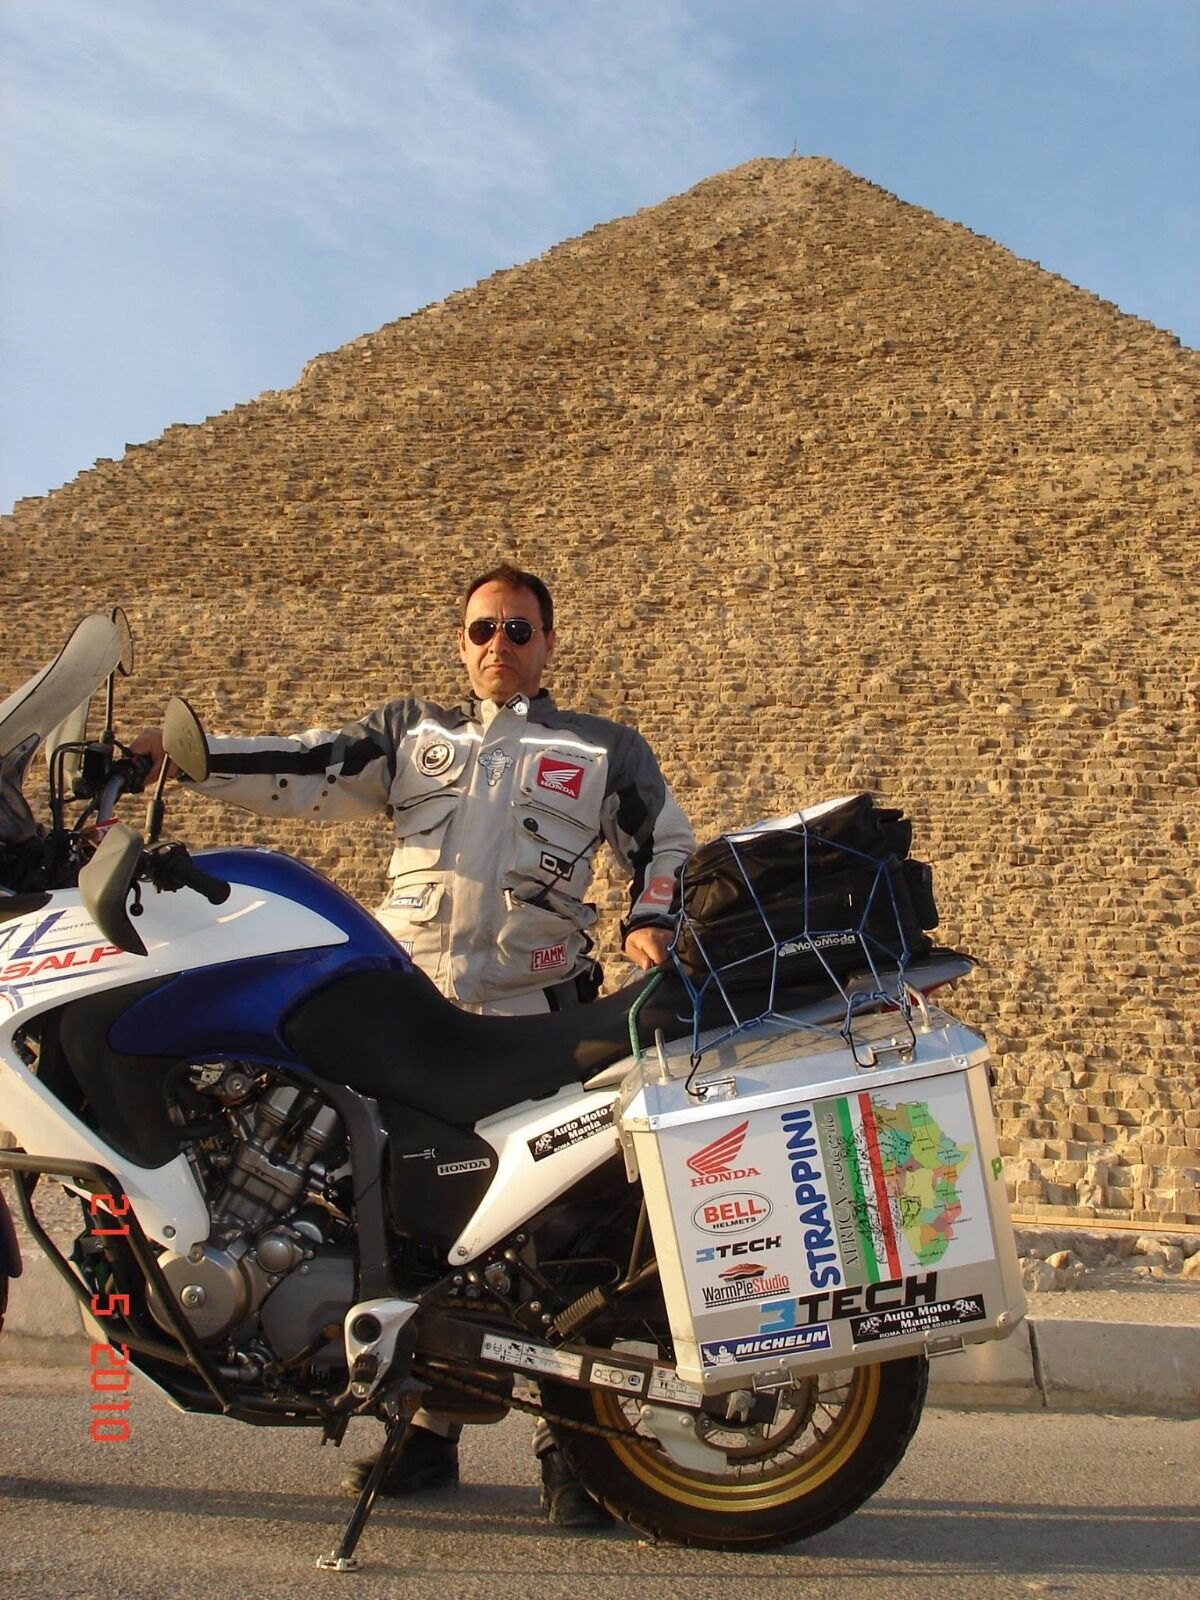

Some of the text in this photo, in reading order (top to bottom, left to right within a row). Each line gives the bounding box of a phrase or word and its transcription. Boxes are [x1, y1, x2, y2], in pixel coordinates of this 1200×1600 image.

[541, 780, 576, 797] HONDA
[794, 934, 856, 952] MooModa
[534, 946, 565, 964] FIAMM
[553, 1106, 608, 1139] Auto Moto
[568, 1120, 601, 1140] Mania
[439, 1160, 488, 1174] HONDA
[690, 1167, 761, 1187] HONDA
[781, 1109, 841, 1289] STRAPPINI
[703, 1199, 762, 1224] BELL
[712, 1216, 757, 1229] HELMETS
[835, 1196, 860, 1266] AFRICA
[702, 1274, 789, 1302] WarmPieStudio
[883, 1302, 951, 1323] Auto Moto
[900, 1315, 940, 1329] Mania
[735, 1330, 828, 1355] MICHELIN
[879, 1331, 900, 1339] ROMA
[901, 1328, 917, 1336] EUR
